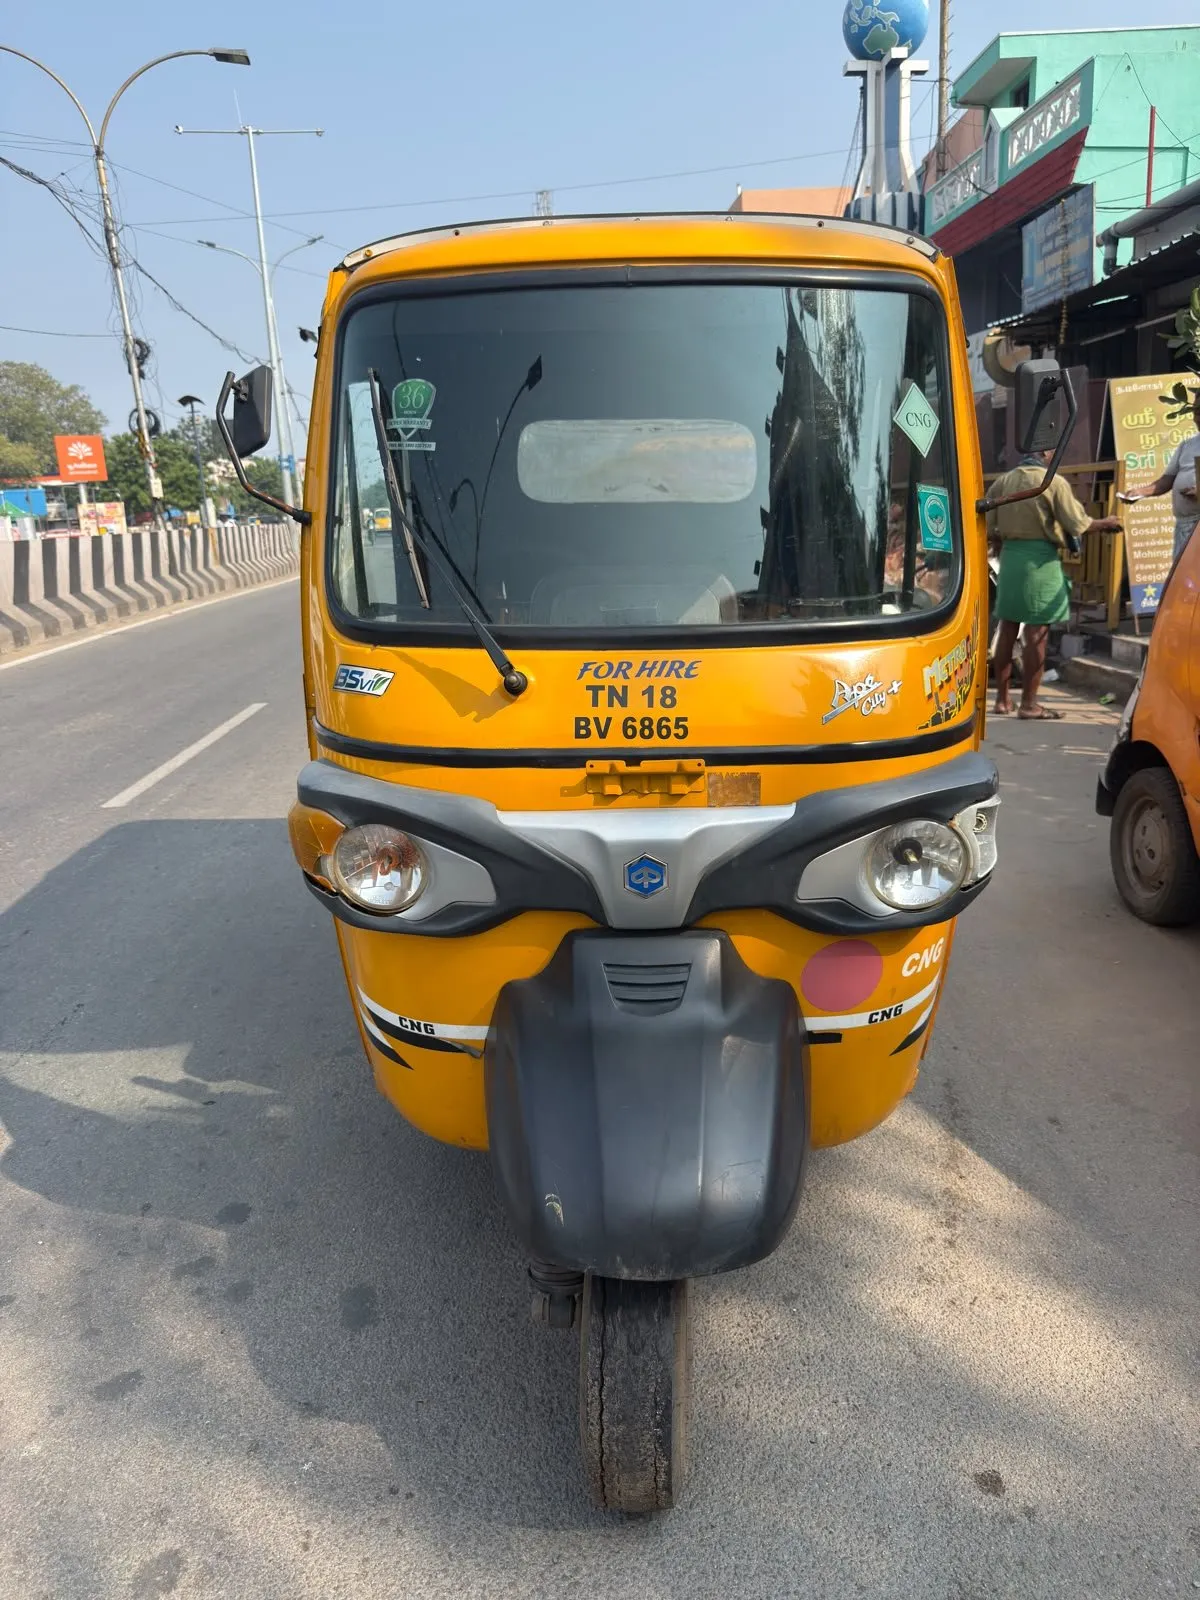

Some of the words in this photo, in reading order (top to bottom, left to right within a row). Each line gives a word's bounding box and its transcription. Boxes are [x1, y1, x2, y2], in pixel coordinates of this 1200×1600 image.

[399, 384, 426, 409] 36
[905, 412, 932, 428] CNG
[1124, 450, 1156, 470] Sri
[1129, 504, 1151, 513] Atho
[1153, 503, 1173, 511] Noo
[577, 661, 633, 680] FOR
[635, 660, 702, 679] HIRE
[585, 685, 629, 708] TN
[641, 685, 678, 708] 18
[830, 673, 884, 710] Ape
[860, 691, 887, 716] City
[574, 716, 613, 739] BV
[622, 716, 689, 739] 6865
[901, 937, 945, 977] CNG
[398, 1016, 436, 1035] CNG
[868, 1004, 904, 1025] CNG
